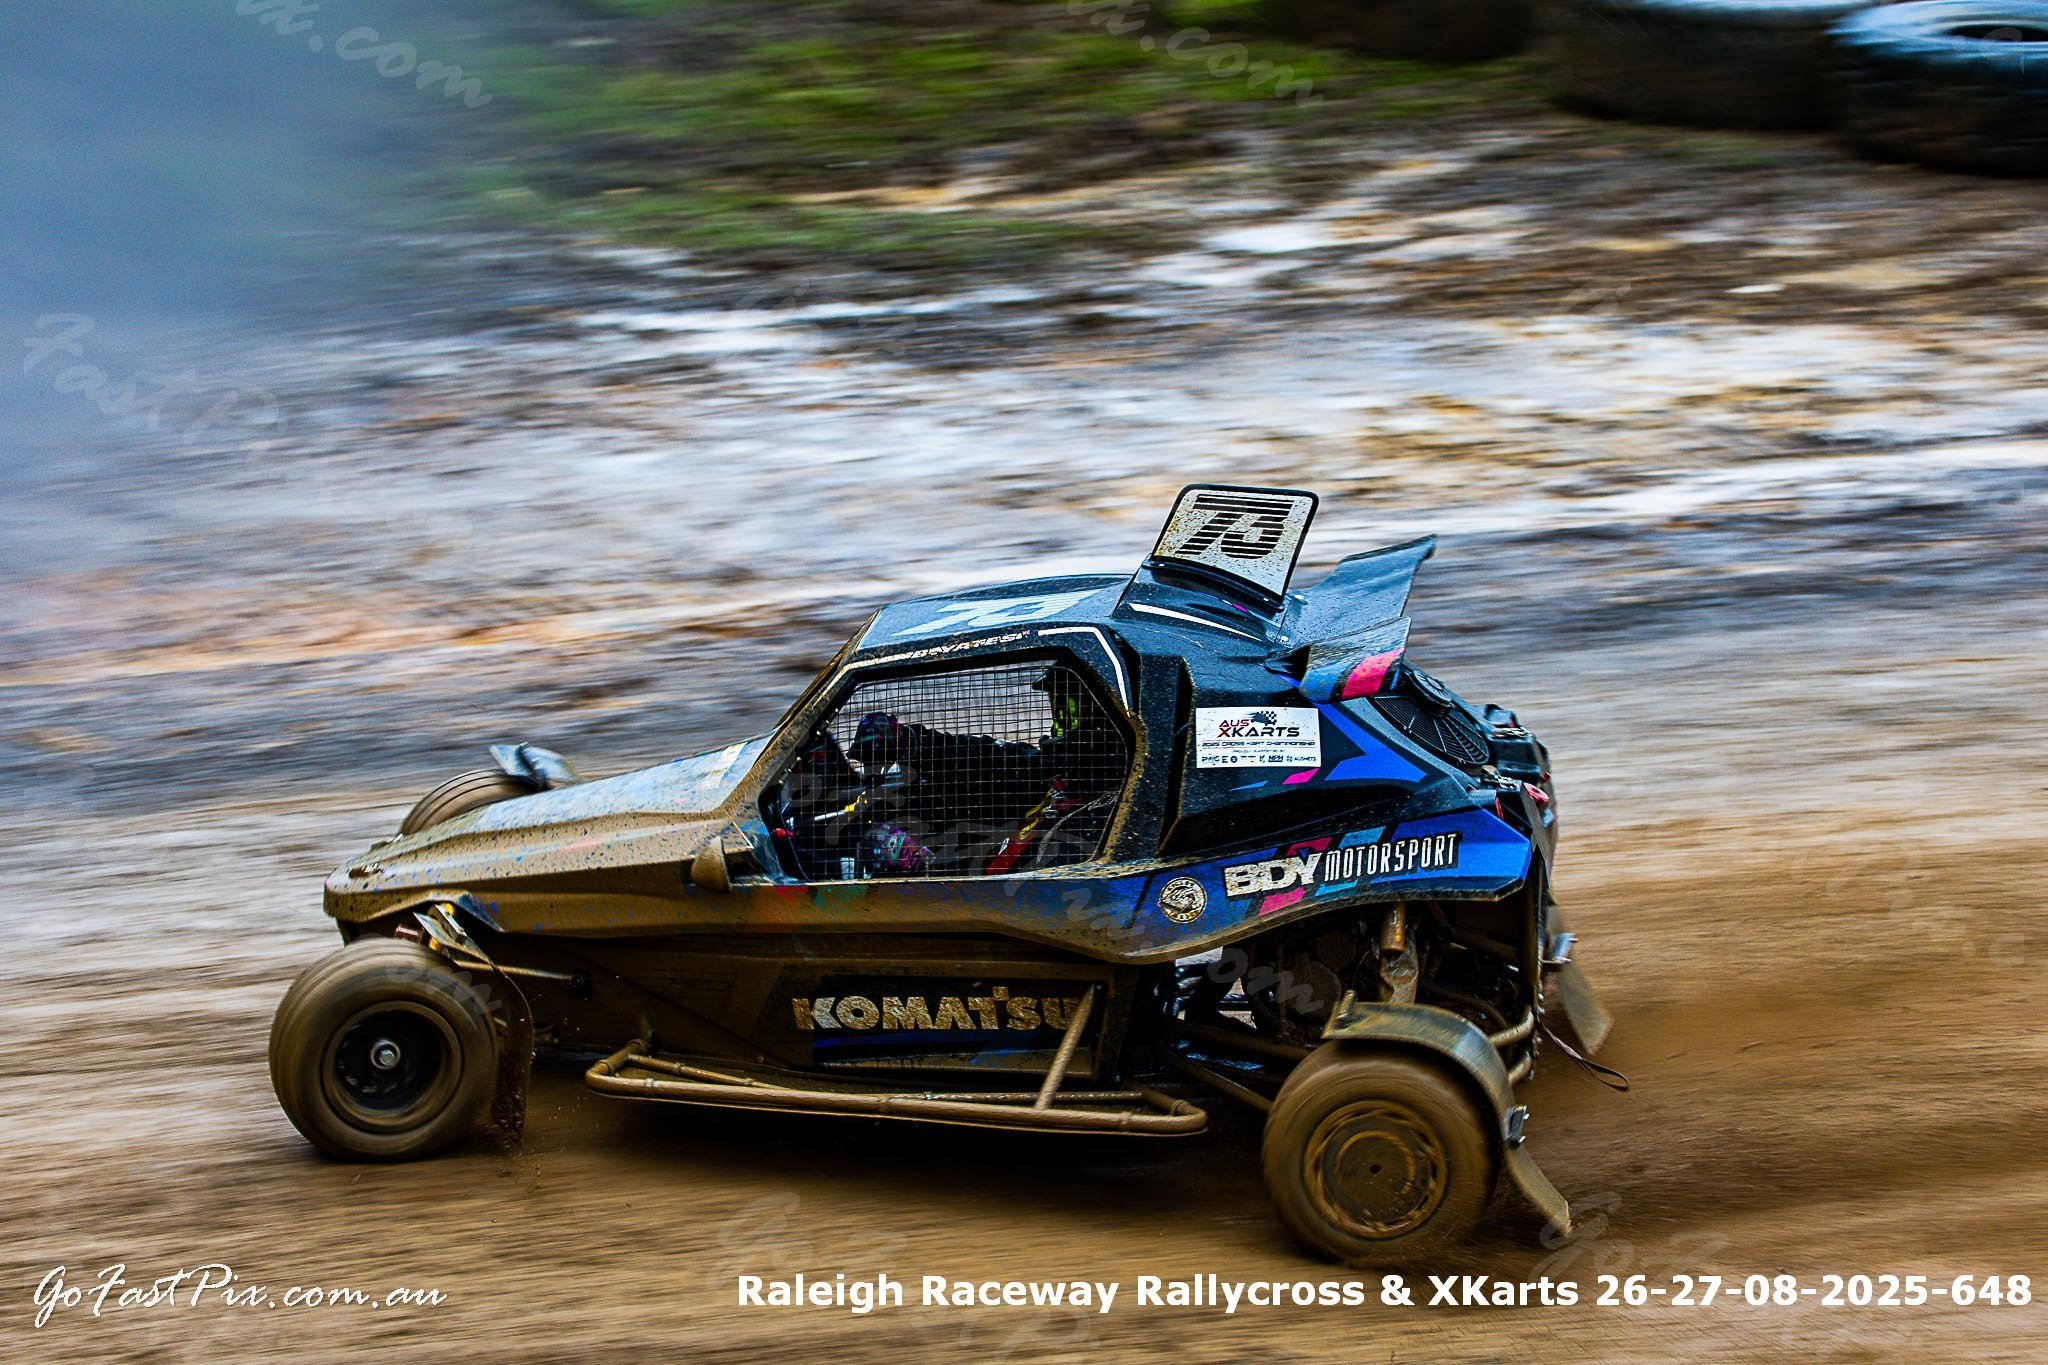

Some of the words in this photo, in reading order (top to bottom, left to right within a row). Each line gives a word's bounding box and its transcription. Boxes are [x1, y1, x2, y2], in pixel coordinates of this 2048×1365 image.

[1174, 493, 1295, 560] 73
[1217, 727, 1300, 738] XKARTS
[1218, 719, 1250, 728] AUS
[1223, 852, 1323, 898] BDY
[1323, 832, 1458, 883] MOTORSPORT
[791, 985, 1082, 1031] KOMATSU
